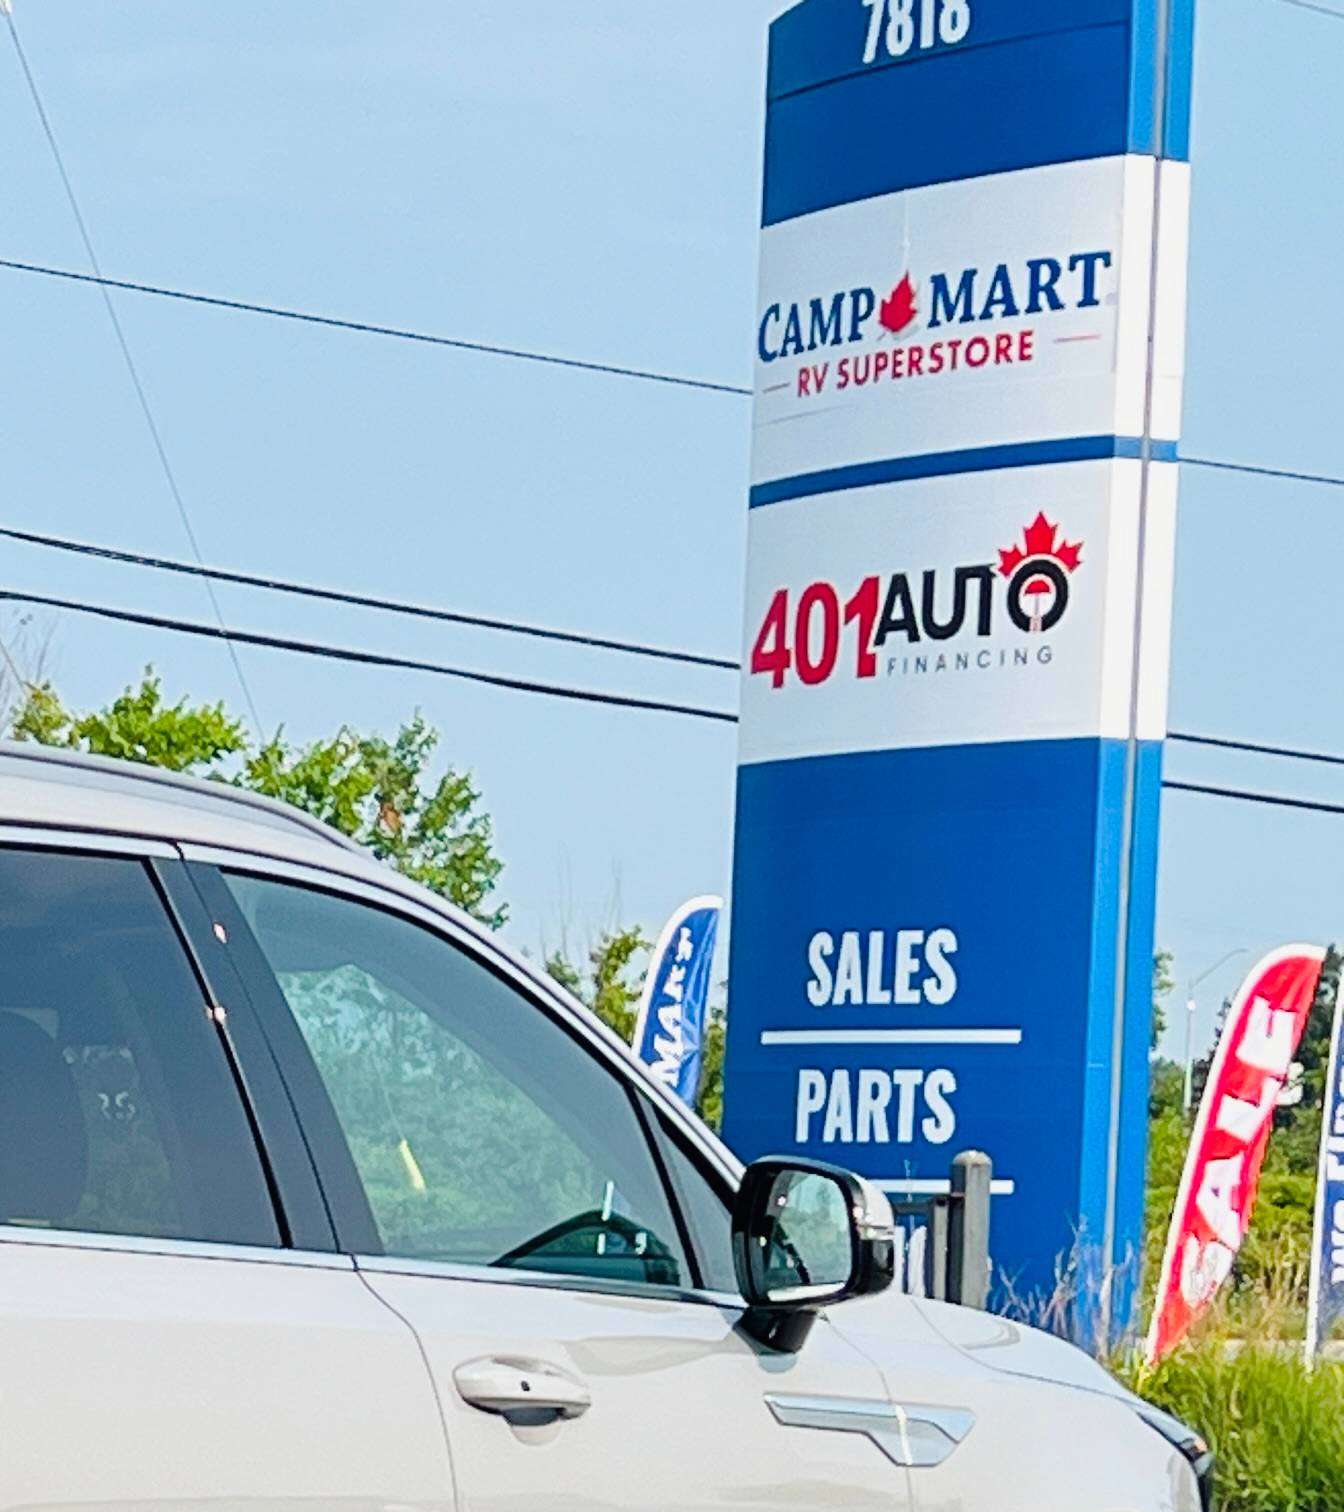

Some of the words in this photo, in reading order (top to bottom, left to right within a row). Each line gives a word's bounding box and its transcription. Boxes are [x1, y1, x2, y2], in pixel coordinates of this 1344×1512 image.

[862, 0, 971, 64] 7818
[758, 286, 875, 363] CAMP
[926, 250, 1112, 329] MART
[796, 363, 830, 398] RV
[836, 329, 1035, 390] SUPERSTORE
[886, 645, 1054, 678] FINANCING
[806, 927, 958, 1007] SALES
[795, 1068, 957, 1144] PARTS
[1179, 995, 1297, 1307] SALE
